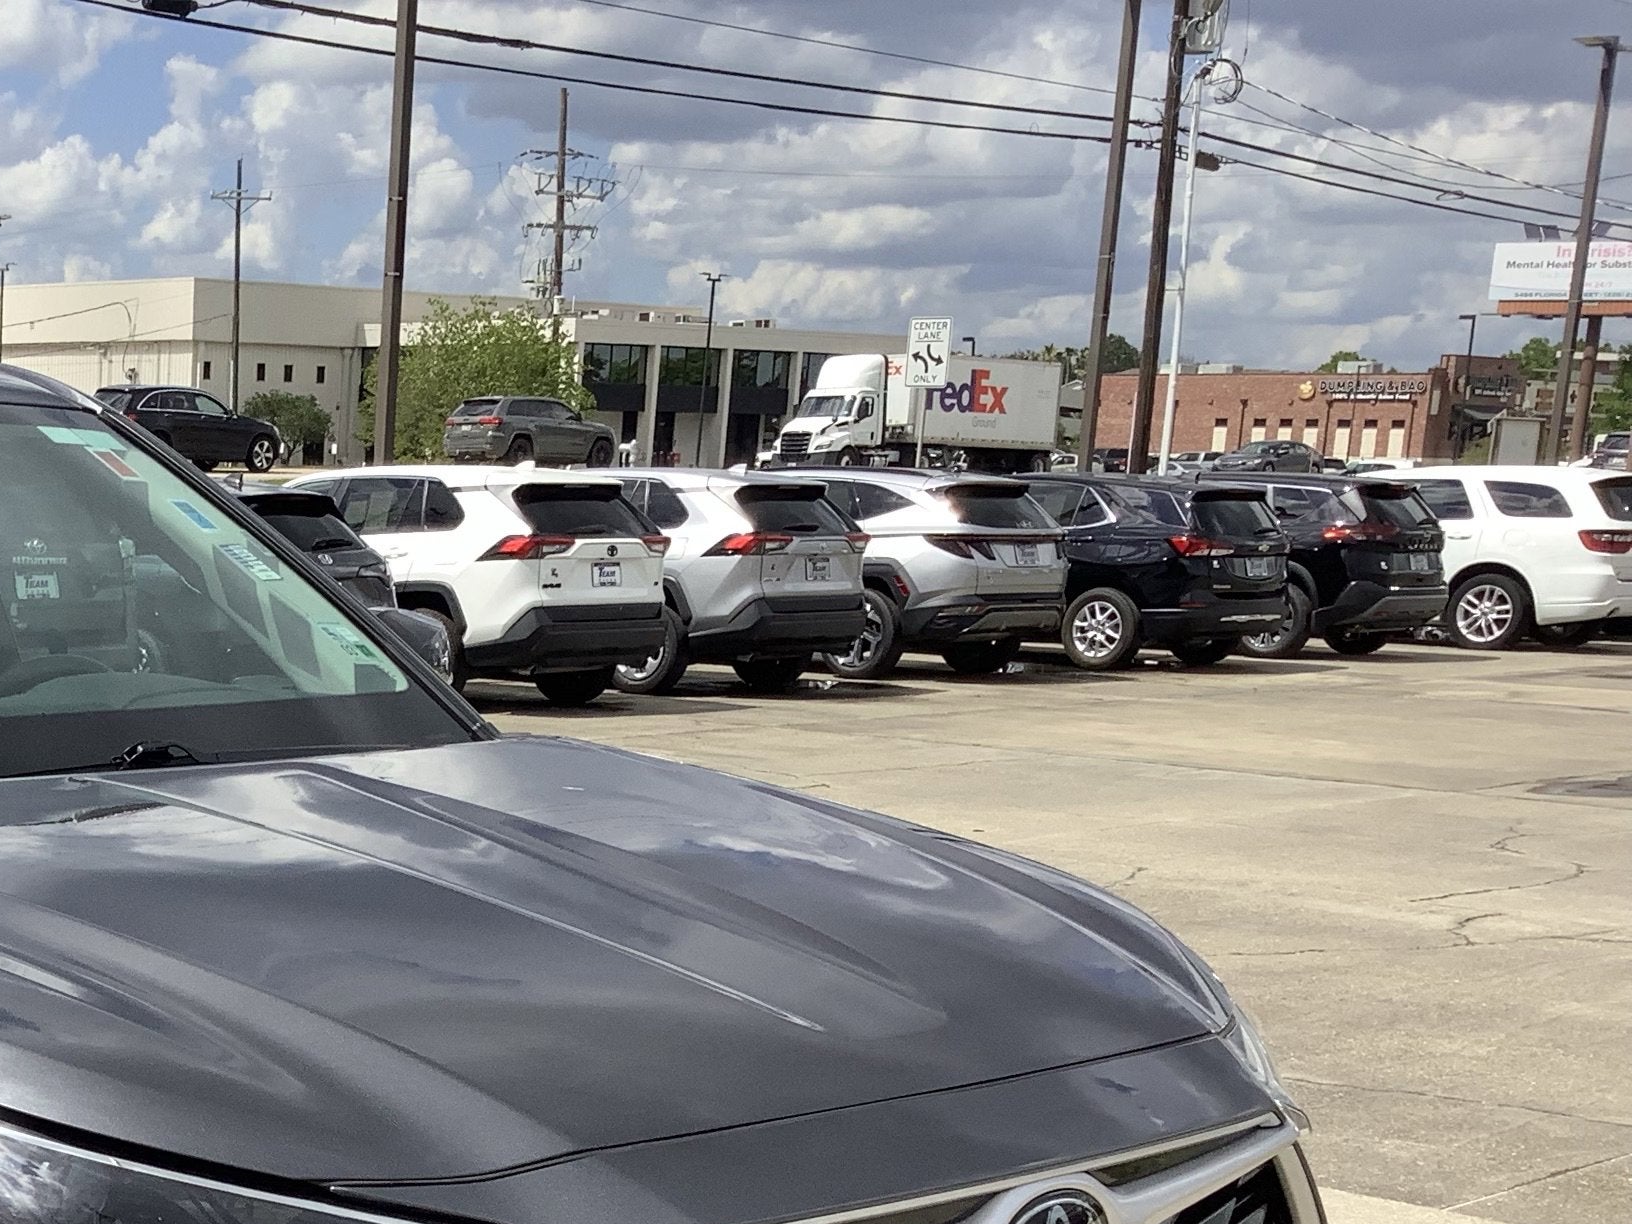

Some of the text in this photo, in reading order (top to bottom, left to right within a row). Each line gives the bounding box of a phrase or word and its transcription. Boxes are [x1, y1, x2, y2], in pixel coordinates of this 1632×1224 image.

[1556, 243, 1632, 258] In risis?
[1506, 261, 1543, 269] Mental
[1546, 261, 1573, 269] Heal
[913, 321, 948, 331] CENTER
[918, 331, 942, 340] LANE
[913, 375, 938, 384] ONLY
[1400, 381, 1425, 392] BAO
[972, 416, 997, 429] Ground
[599, 566, 616, 578] TEAM
[23, 575, 49, 588] TEAM
